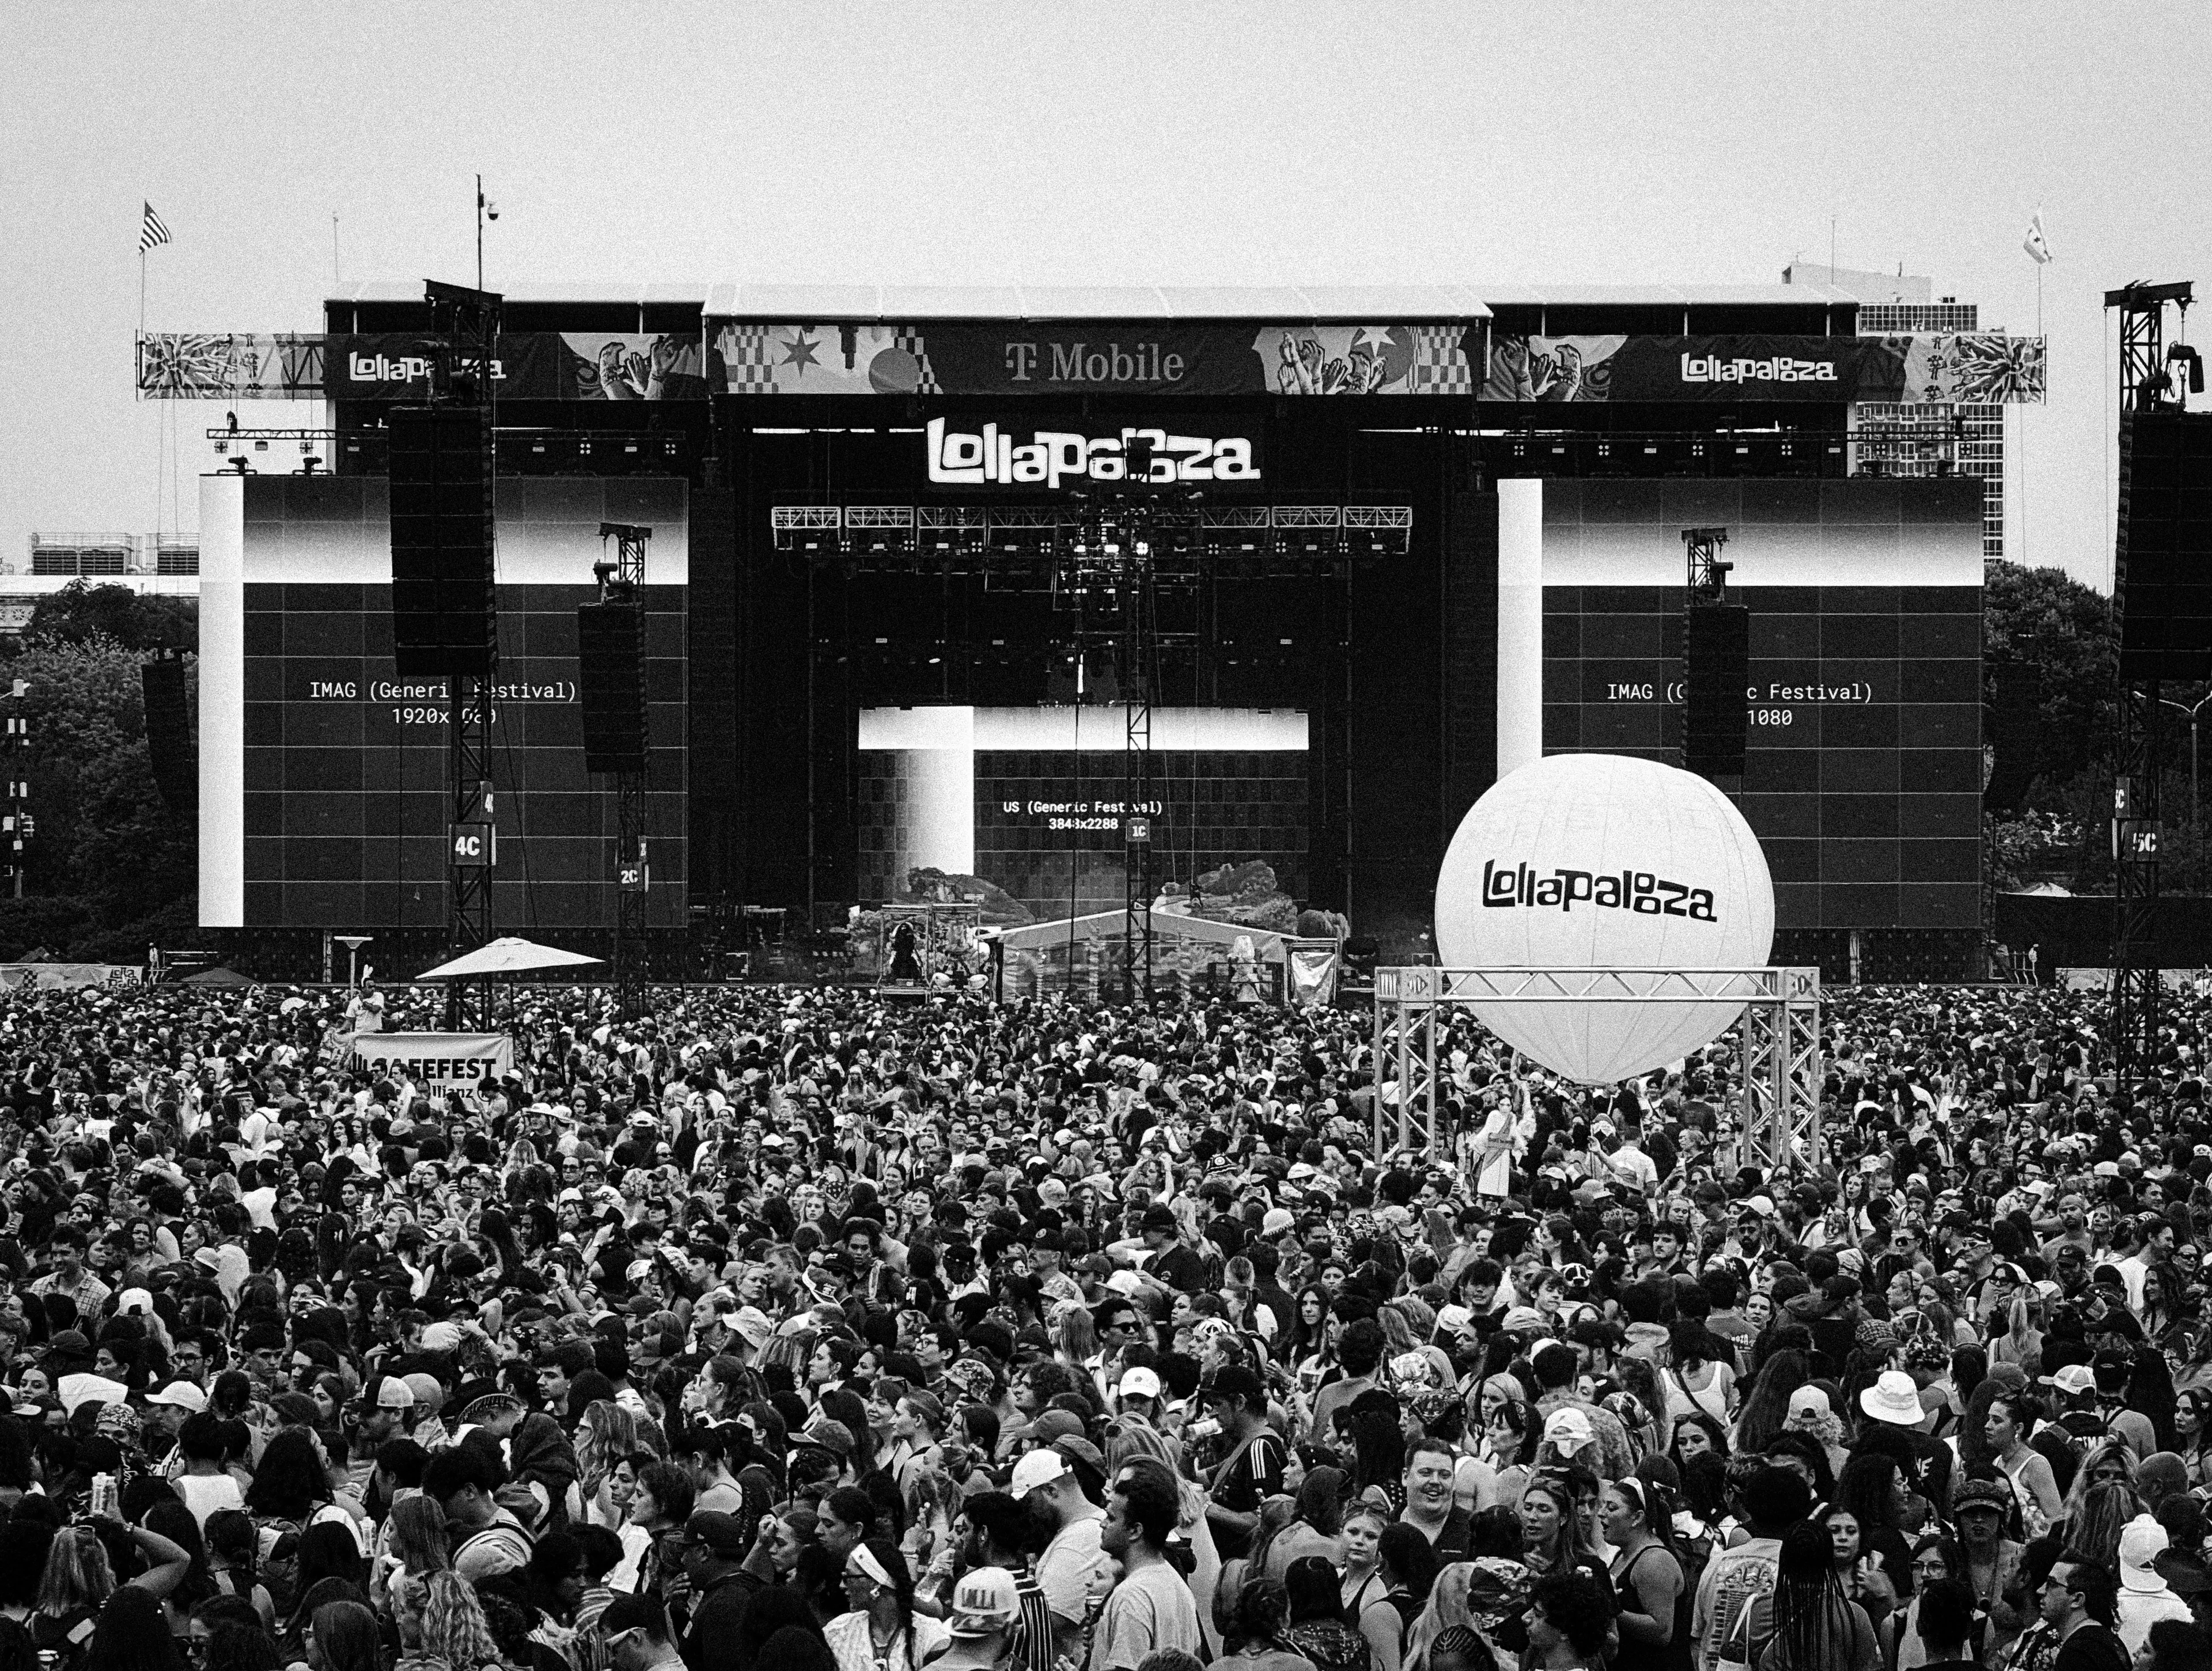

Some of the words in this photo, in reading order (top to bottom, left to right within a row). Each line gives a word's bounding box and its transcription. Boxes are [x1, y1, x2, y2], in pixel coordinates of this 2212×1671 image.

[1048, 342, 1184, 381] Mobile
[1681, 352, 1838, 384] Lollapalooza
[310, 681, 357, 698] IMAG
[370, 681, 450, 702] (Generi
[1607, 684, 1653, 700] IMAG
[1770, 683, 1872, 704] Festival)
[1003, 801, 1020, 813] US
[1094, 799, 1162, 816] Festval)
[1131, 825, 1147, 838] 1C
[454, 836, 480, 857] 4C
[620, 869, 638, 884] 2C
[1482, 858, 1717, 922] Lollapalooza
